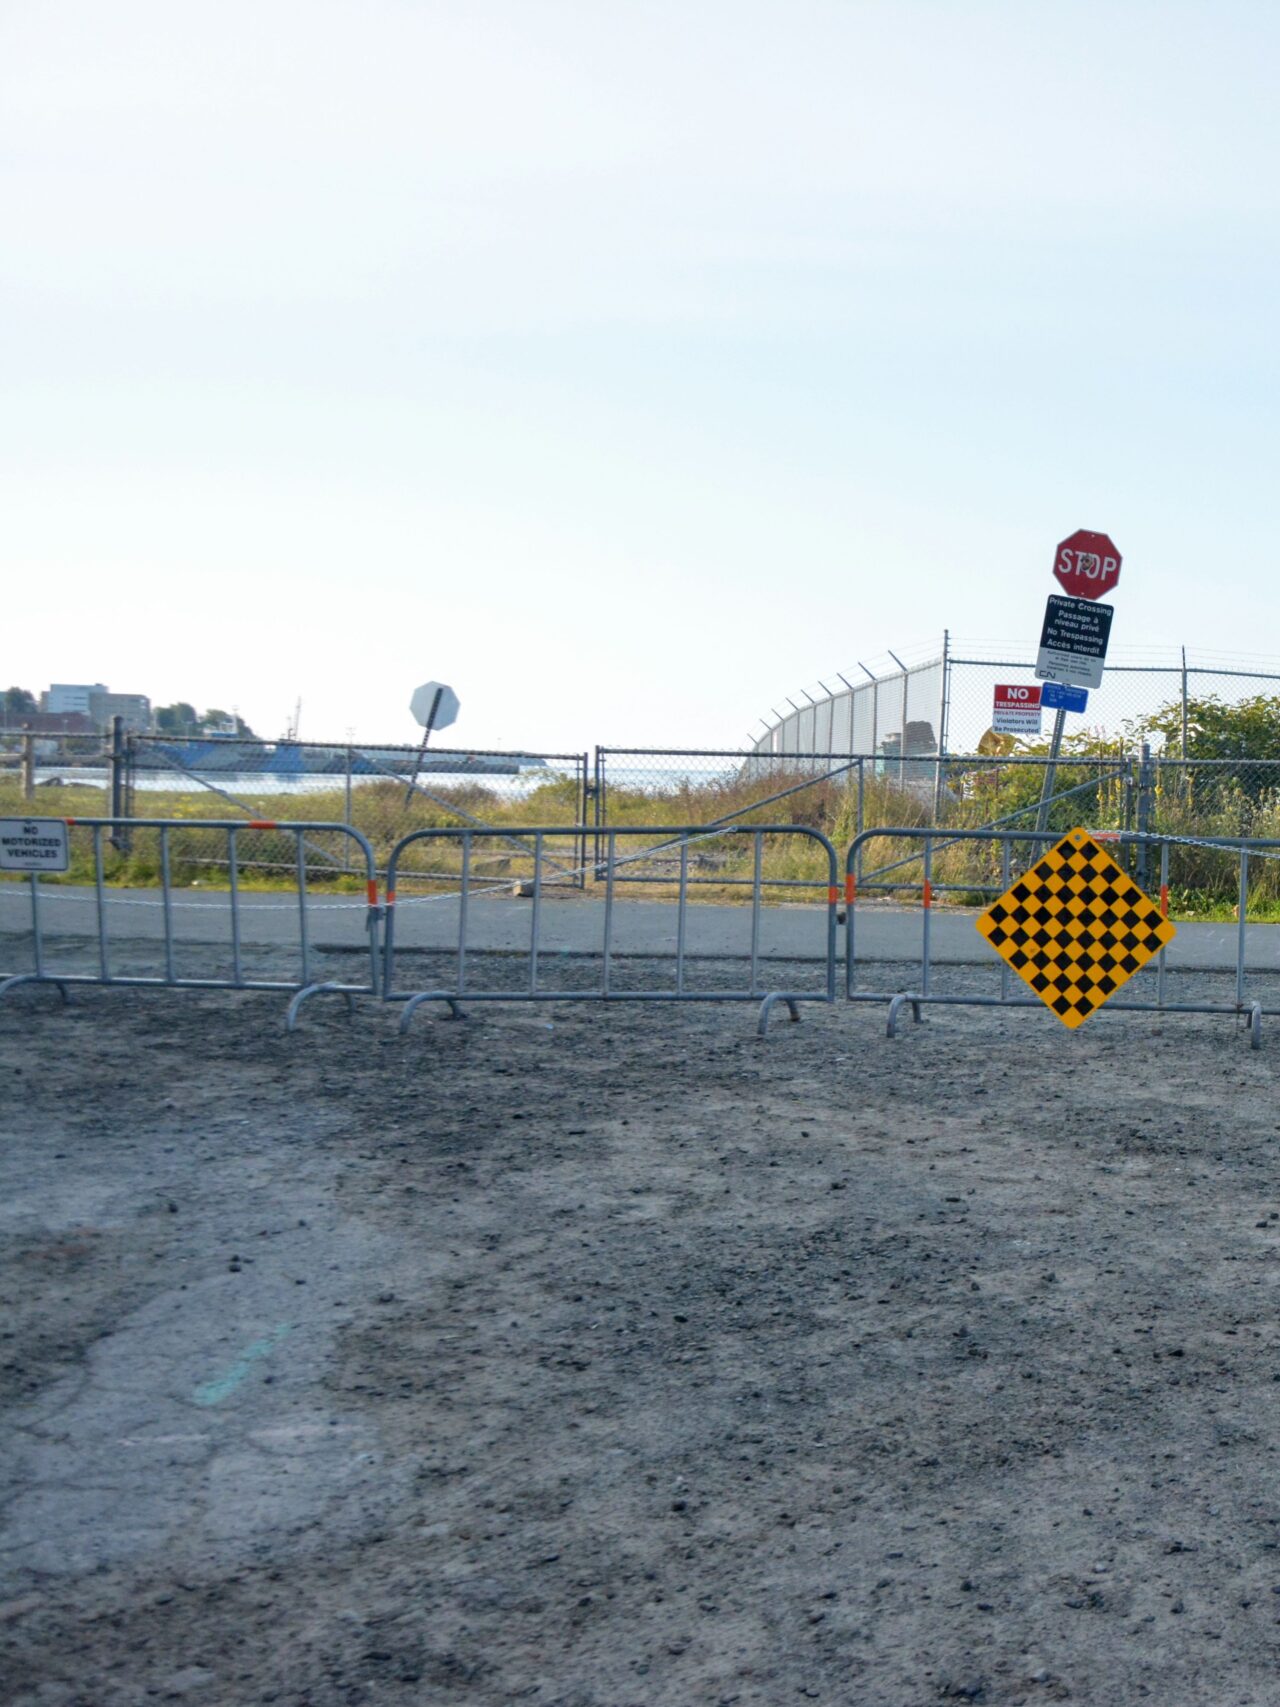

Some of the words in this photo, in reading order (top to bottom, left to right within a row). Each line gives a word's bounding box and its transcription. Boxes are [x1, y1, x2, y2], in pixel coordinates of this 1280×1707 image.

[1058, 548, 1117, 581] STOP
[1049, 597, 1075, 608] Private
[1078, 602, 1112, 616] Crossing
[1058, 609, 1091, 623] Passage
[1054, 618, 1079, 629] niveau
[1080, 624, 1100, 632] privé
[1047, 627, 1058, 636] No
[1060, 629, 1104, 645] Trespassing
[1047, 639, 1071, 649] Accès
[1073, 644, 1100, 654] interdit
[1039, 670, 1056, 679] CN
[1007, 687, 1029, 700] NO
[995, 701, 1040, 709] TRESPASSING
[23, 826, 38, 835] NO
[2, 837, 61, 847] MOTORIZED
[7, 849, 58, 858] VEHICLES
